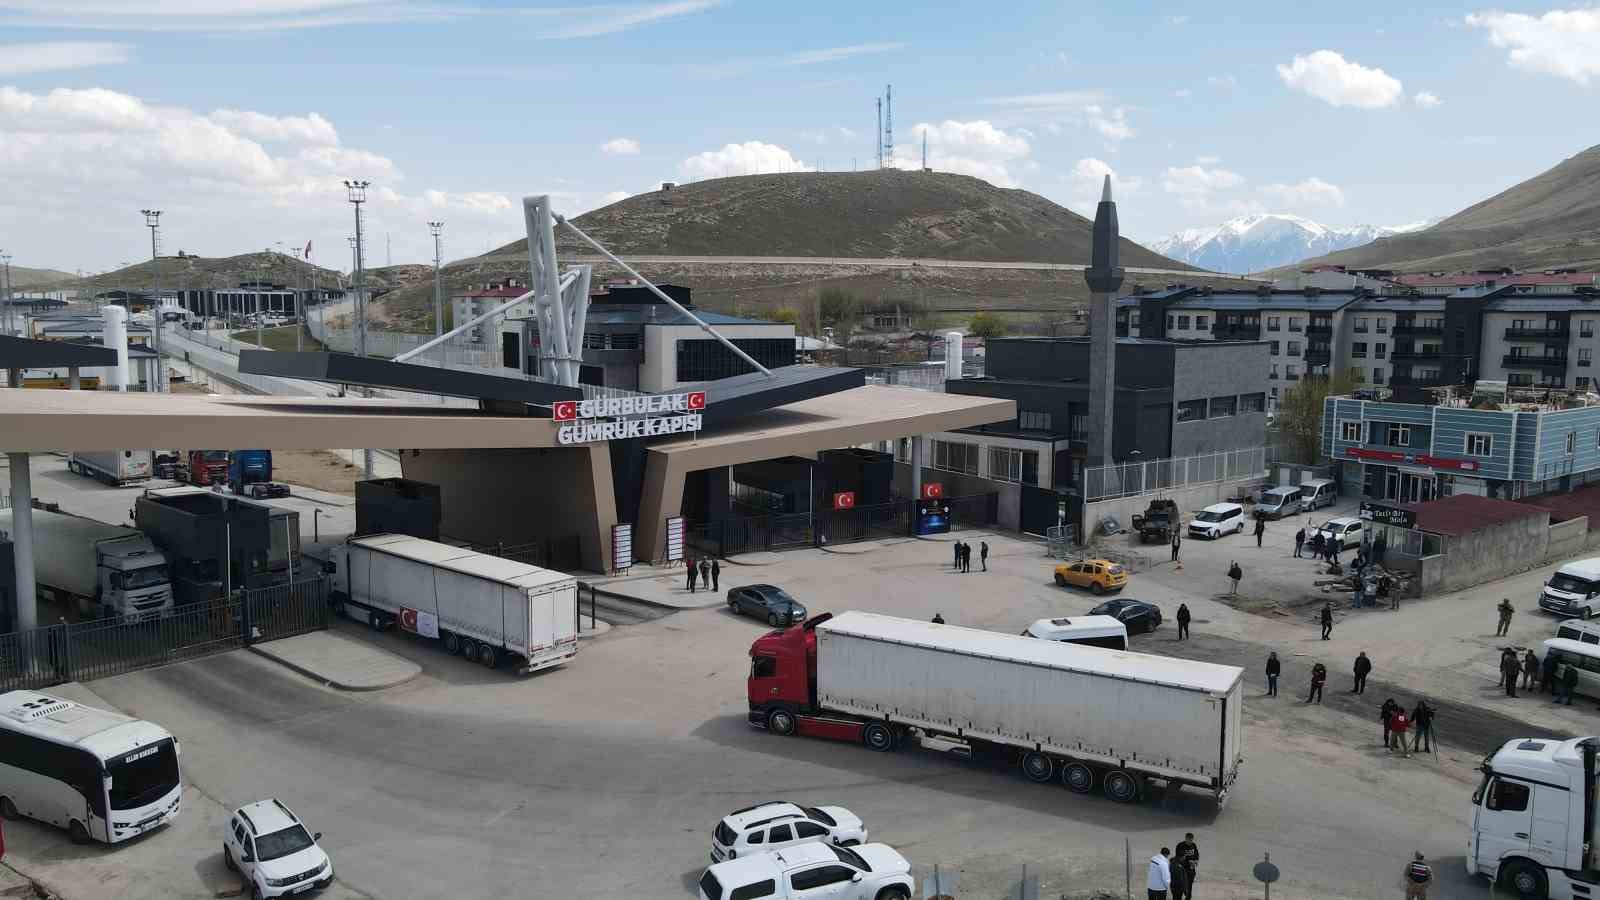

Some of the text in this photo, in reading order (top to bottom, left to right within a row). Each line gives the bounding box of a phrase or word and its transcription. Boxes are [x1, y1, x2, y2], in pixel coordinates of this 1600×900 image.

[580, 393, 687, 418] GÜRBULAK
[558, 414, 702, 444] GÜMRÜK KAPISI
